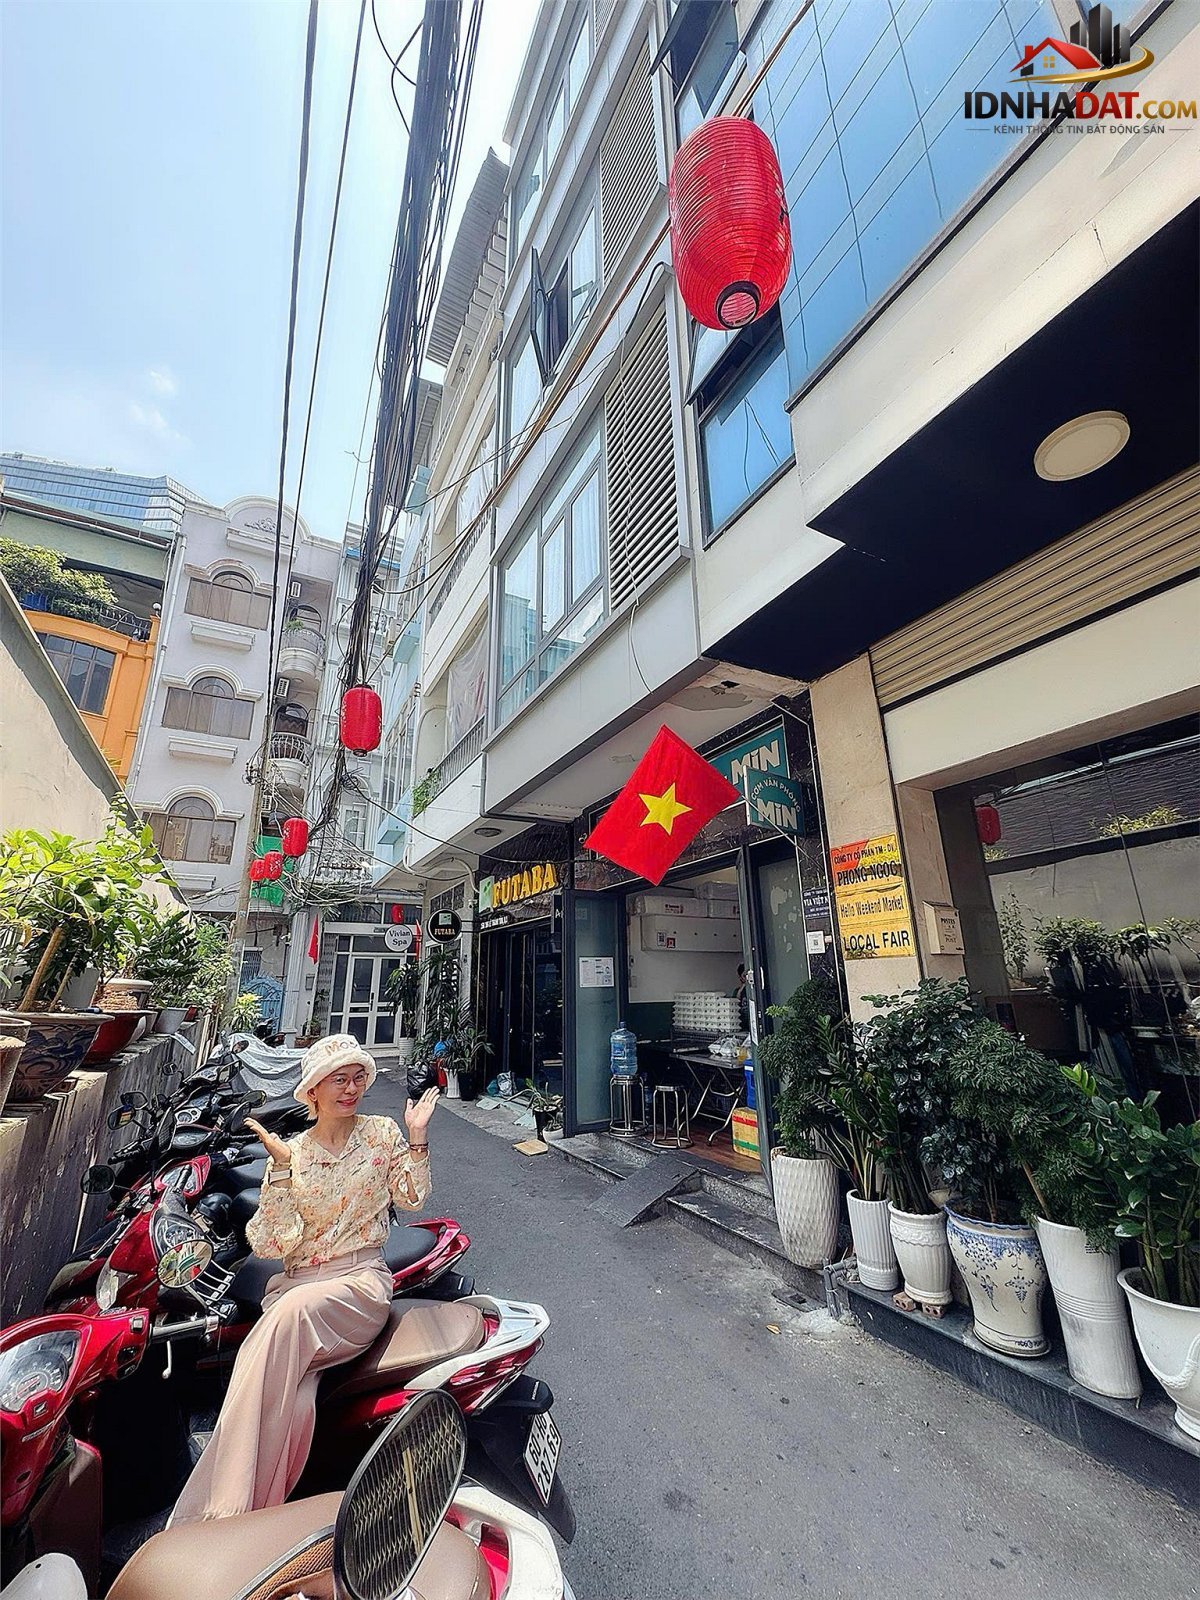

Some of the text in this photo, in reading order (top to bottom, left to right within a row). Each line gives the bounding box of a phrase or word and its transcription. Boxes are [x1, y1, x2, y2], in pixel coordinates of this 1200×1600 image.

[846, 852, 853, 861] TY
[493, 863, 557, 908] FUTABA
[837, 866, 868, 887] PHONG
[840, 902, 855, 918] Hello
[855, 898, 881, 916] Weekend
[882, 895, 904, 912] Market
[389, 929, 411, 938] Vivian
[392, 938, 408, 947] Spa
[843, 930, 911, 951] LOCAL FAIR
[537, 1424, 559, 1499] 287.69
